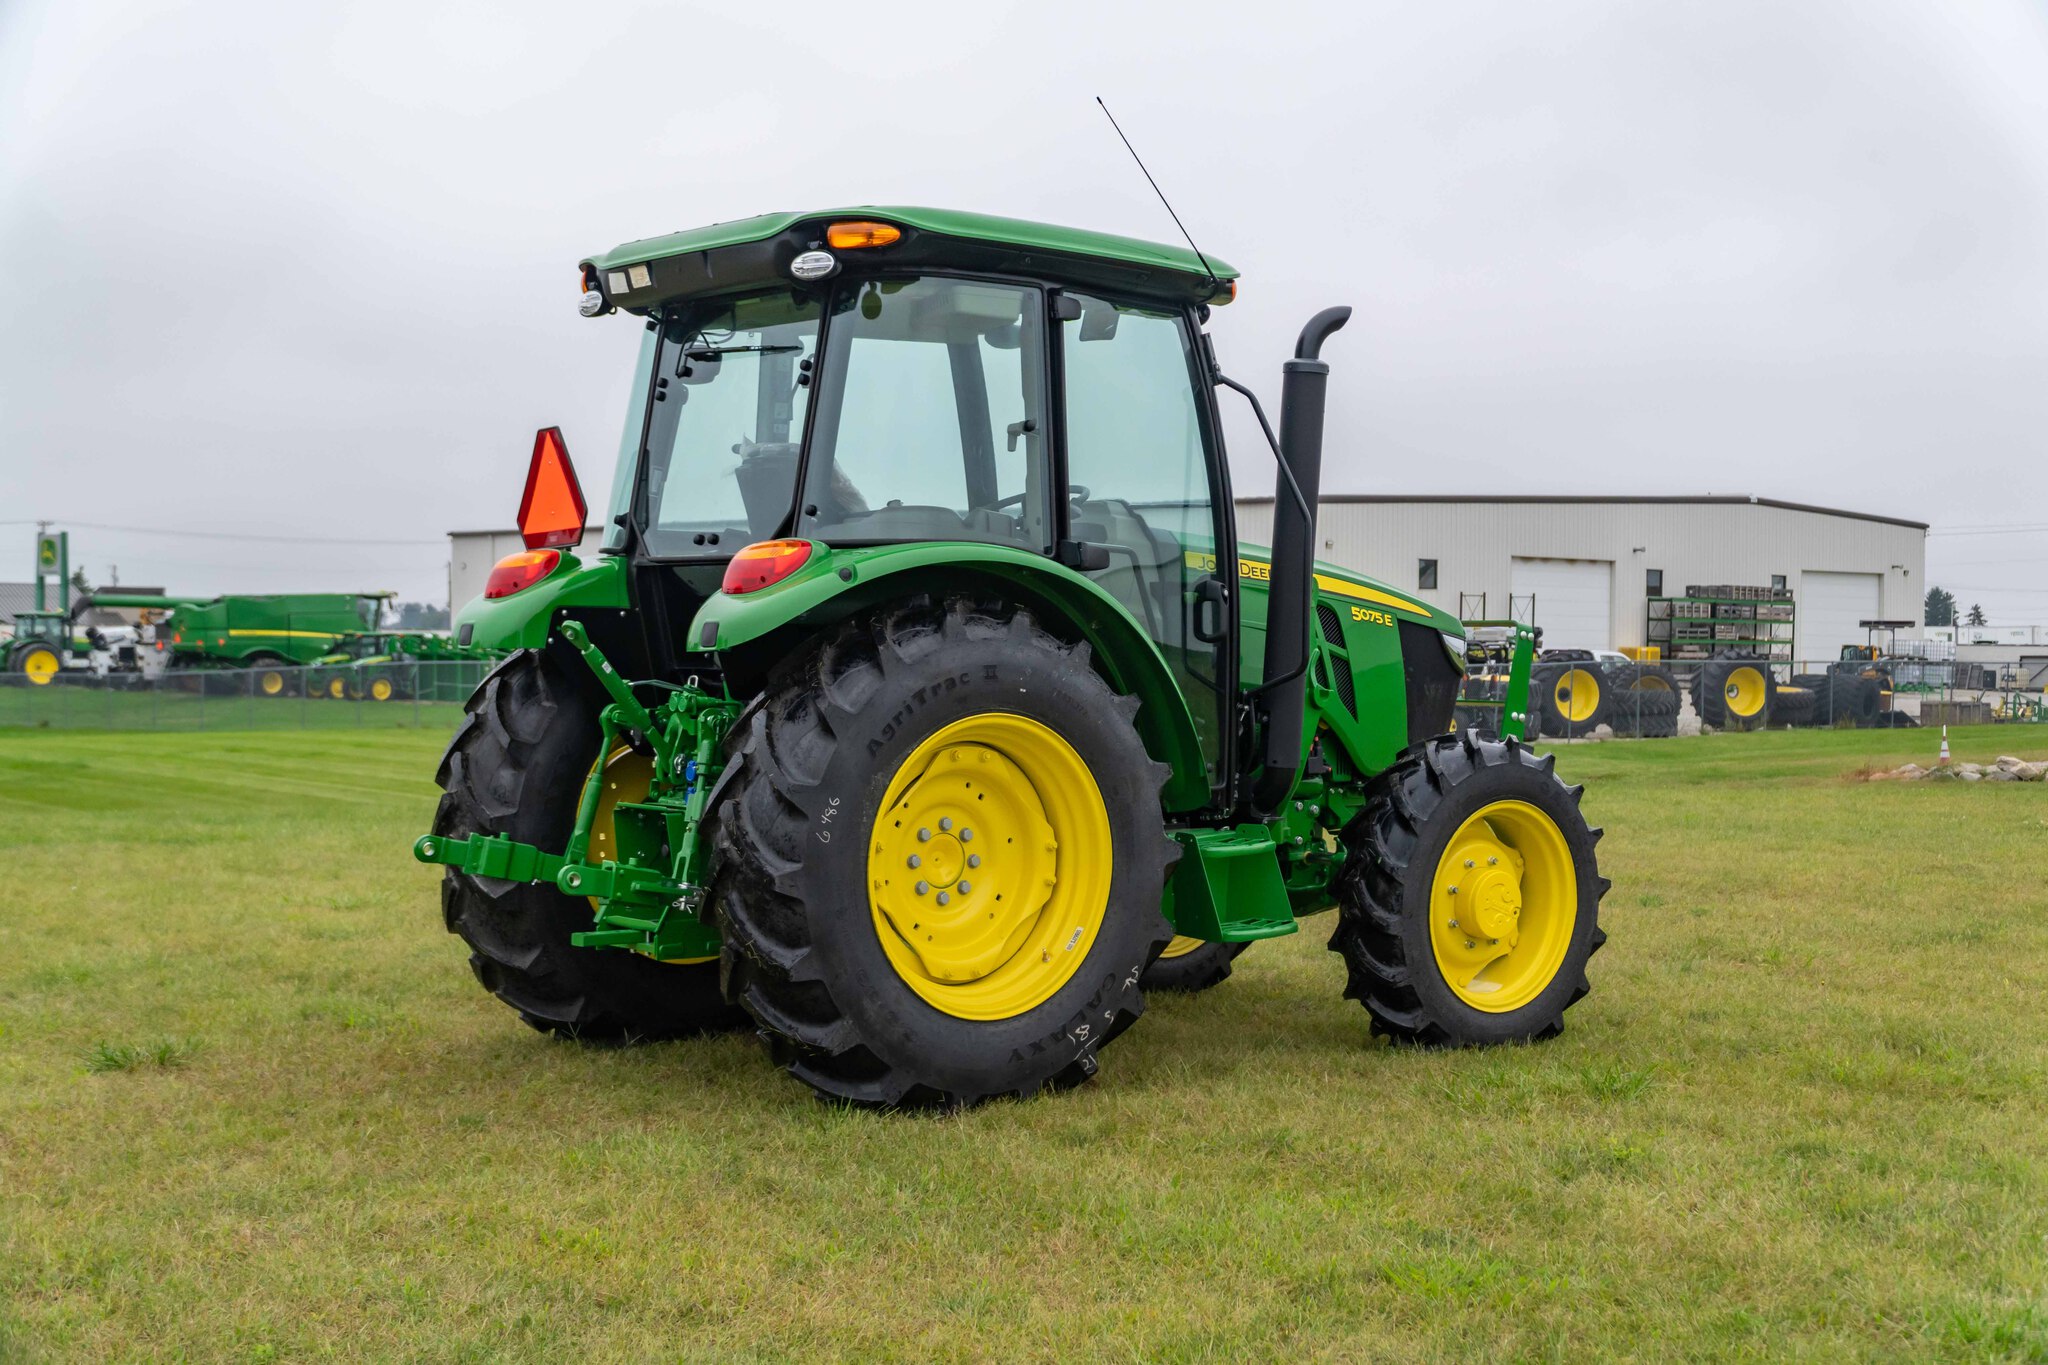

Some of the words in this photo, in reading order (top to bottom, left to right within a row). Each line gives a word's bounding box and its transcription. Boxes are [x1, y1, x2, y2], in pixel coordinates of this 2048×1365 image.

[1239, 562, 1271, 579] DEE
[1351, 606, 1384, 625] 5075
[1384, 613, 1393, 627] E
[866, 672, 970, 758] AgriTrac
